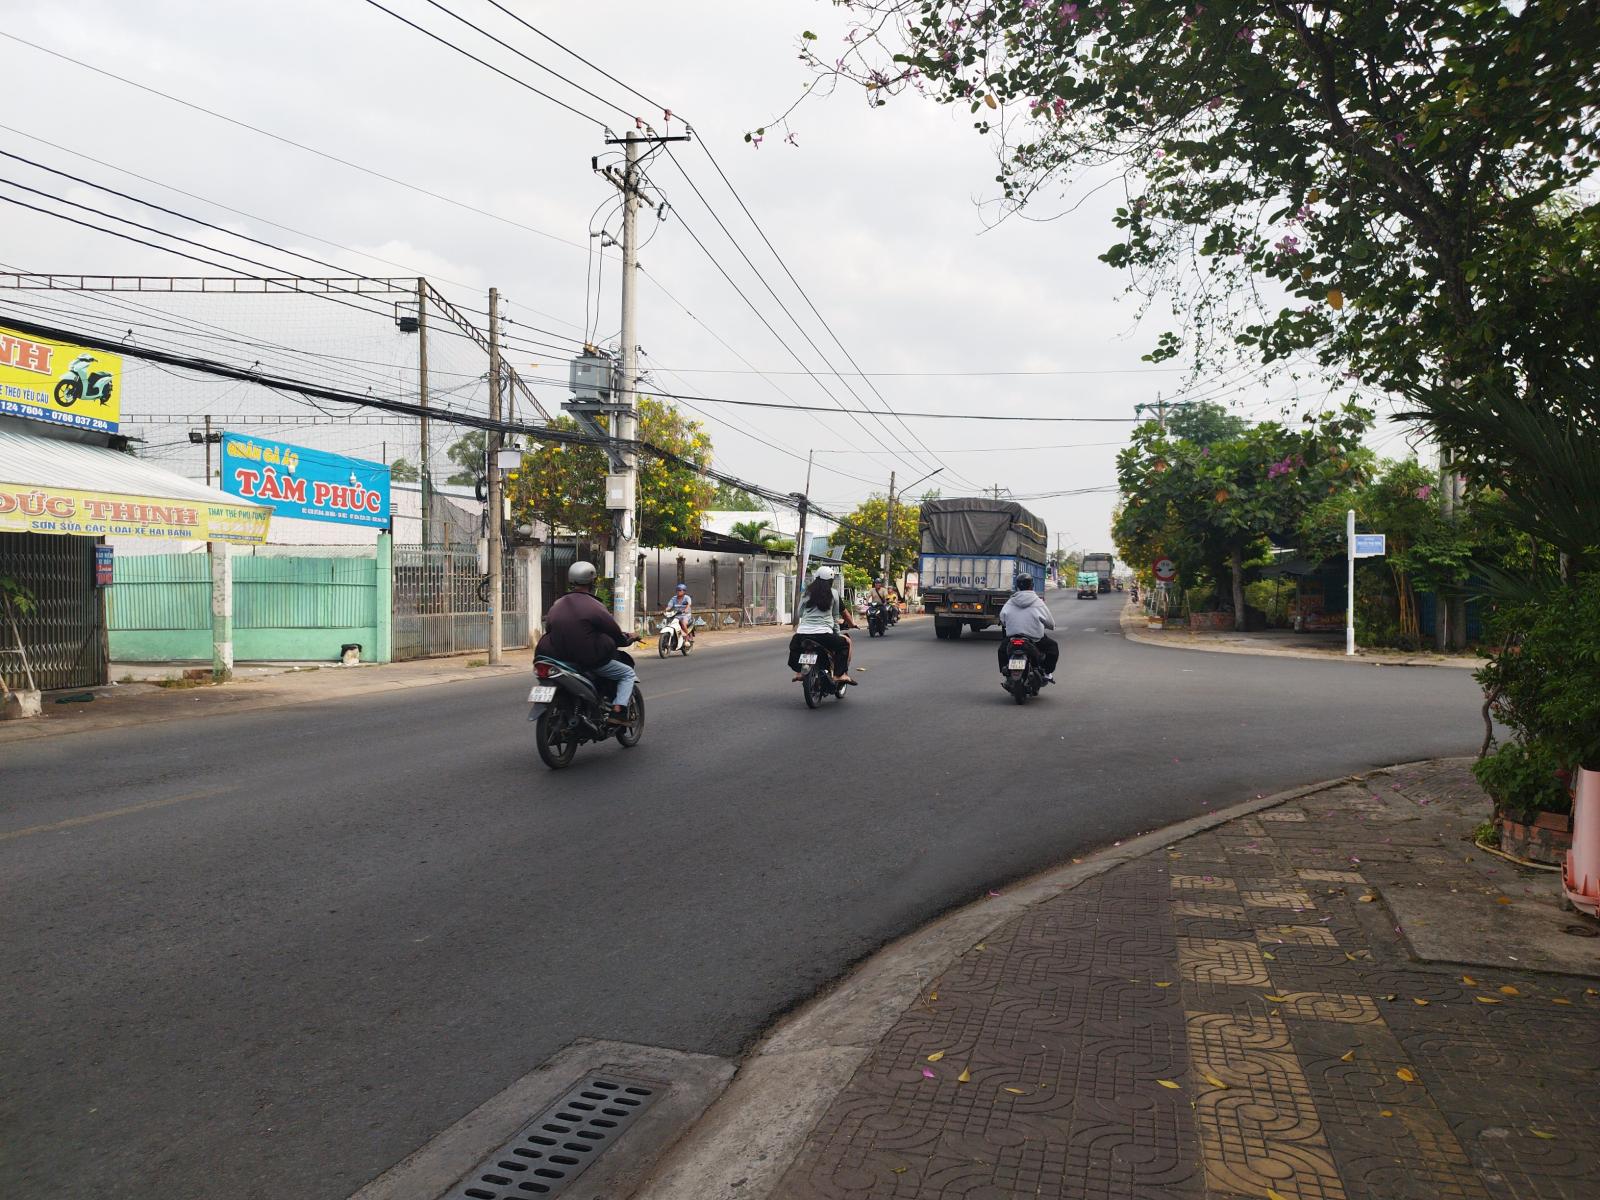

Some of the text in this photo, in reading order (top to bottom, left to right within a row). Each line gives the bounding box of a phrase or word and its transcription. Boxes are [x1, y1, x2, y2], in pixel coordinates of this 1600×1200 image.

[5, 385, 21, 398] THEO
[1, 401, 18, 412] 124
[75, 415, 91, 426] 037
[93, 419, 108, 430] 284
[236, 466, 381, 514] TÂM PHÚC
[83, 499, 199, 527] THỊNH
[134, 527, 146, 536] XE
[149, 528, 165, 537] HAI
